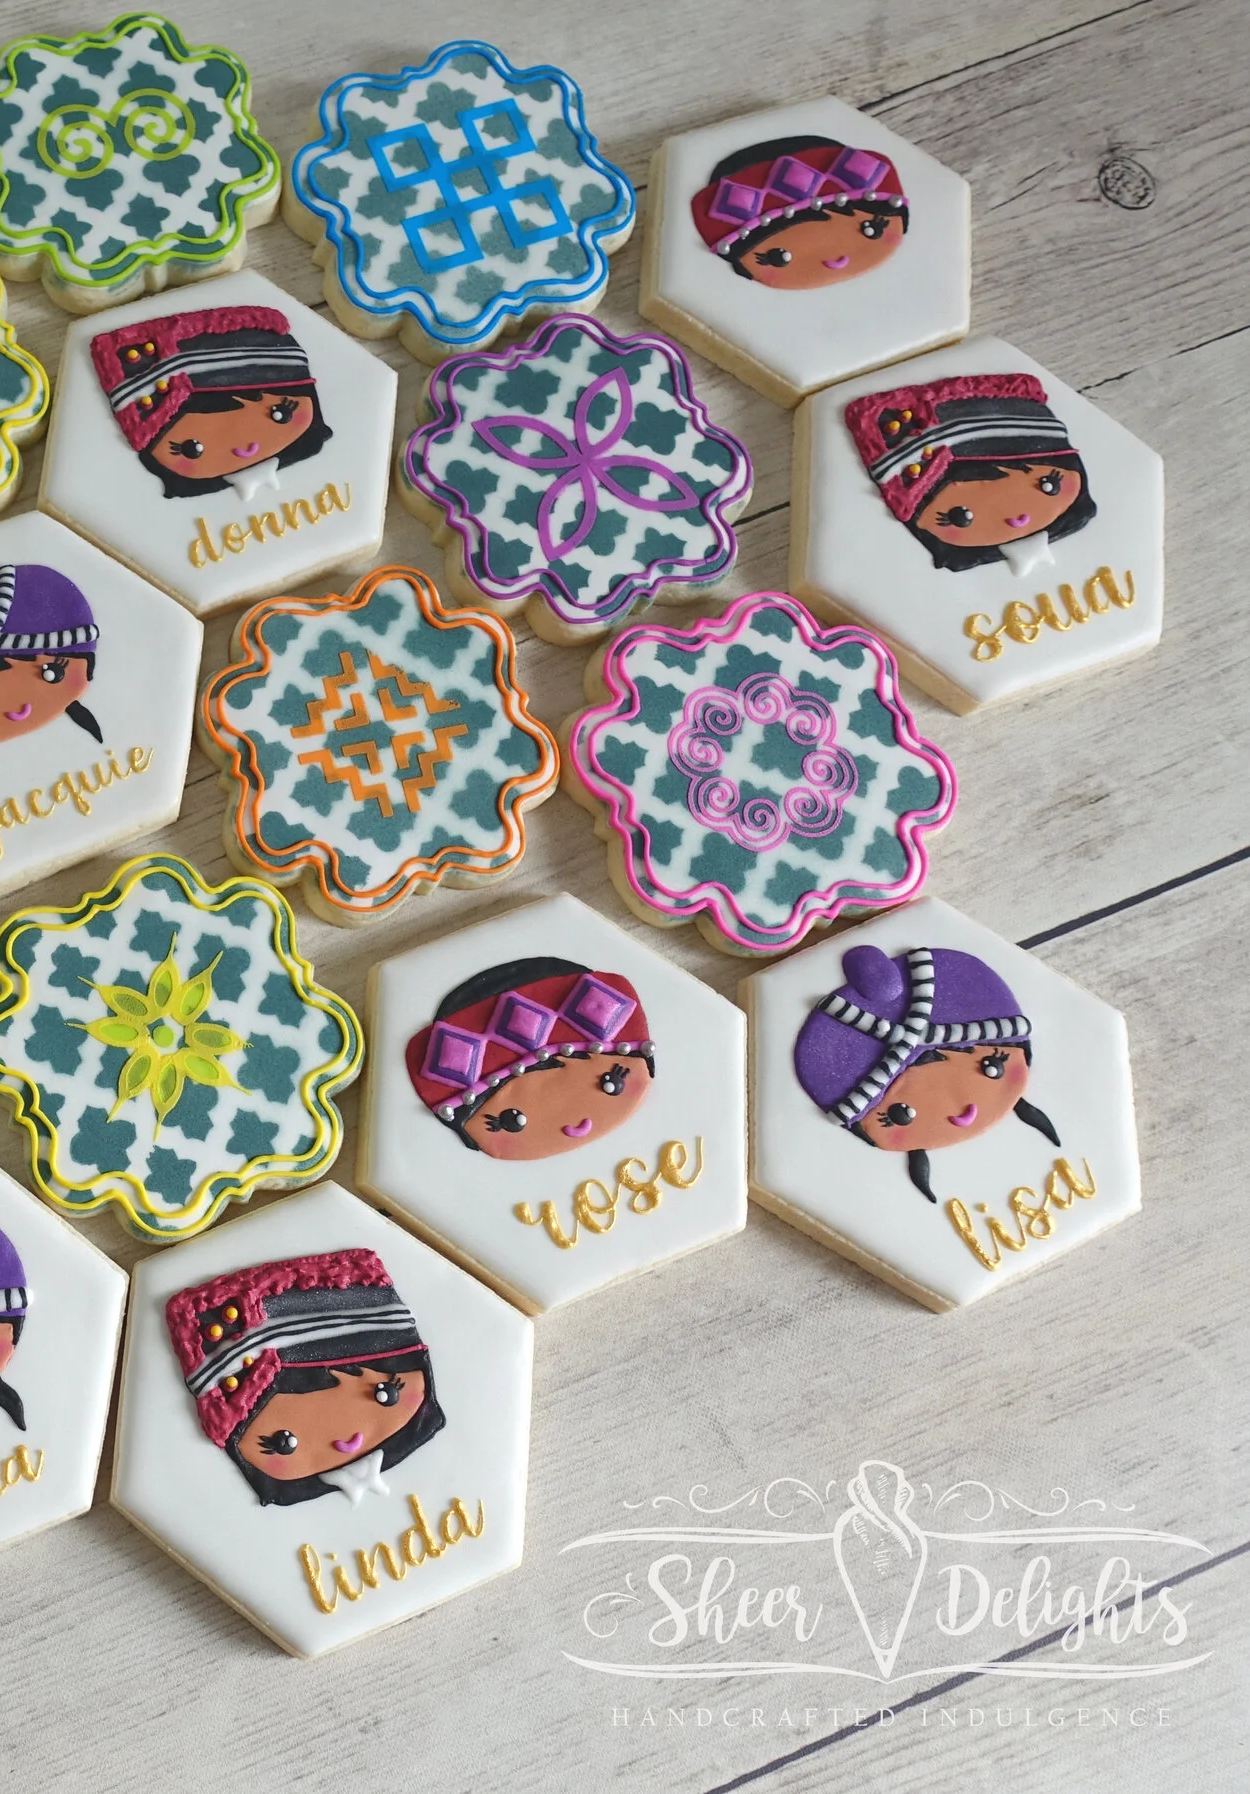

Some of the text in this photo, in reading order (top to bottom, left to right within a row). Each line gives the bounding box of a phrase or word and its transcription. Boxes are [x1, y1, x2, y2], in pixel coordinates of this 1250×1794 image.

[184, 482, 352, 567] donna
[965, 565, 1136, 662] soua
[513, 1138, 703, 1252] rose
[945, 1156, 1097, 1272] lisa
[300, 1493, 483, 1614] linda
